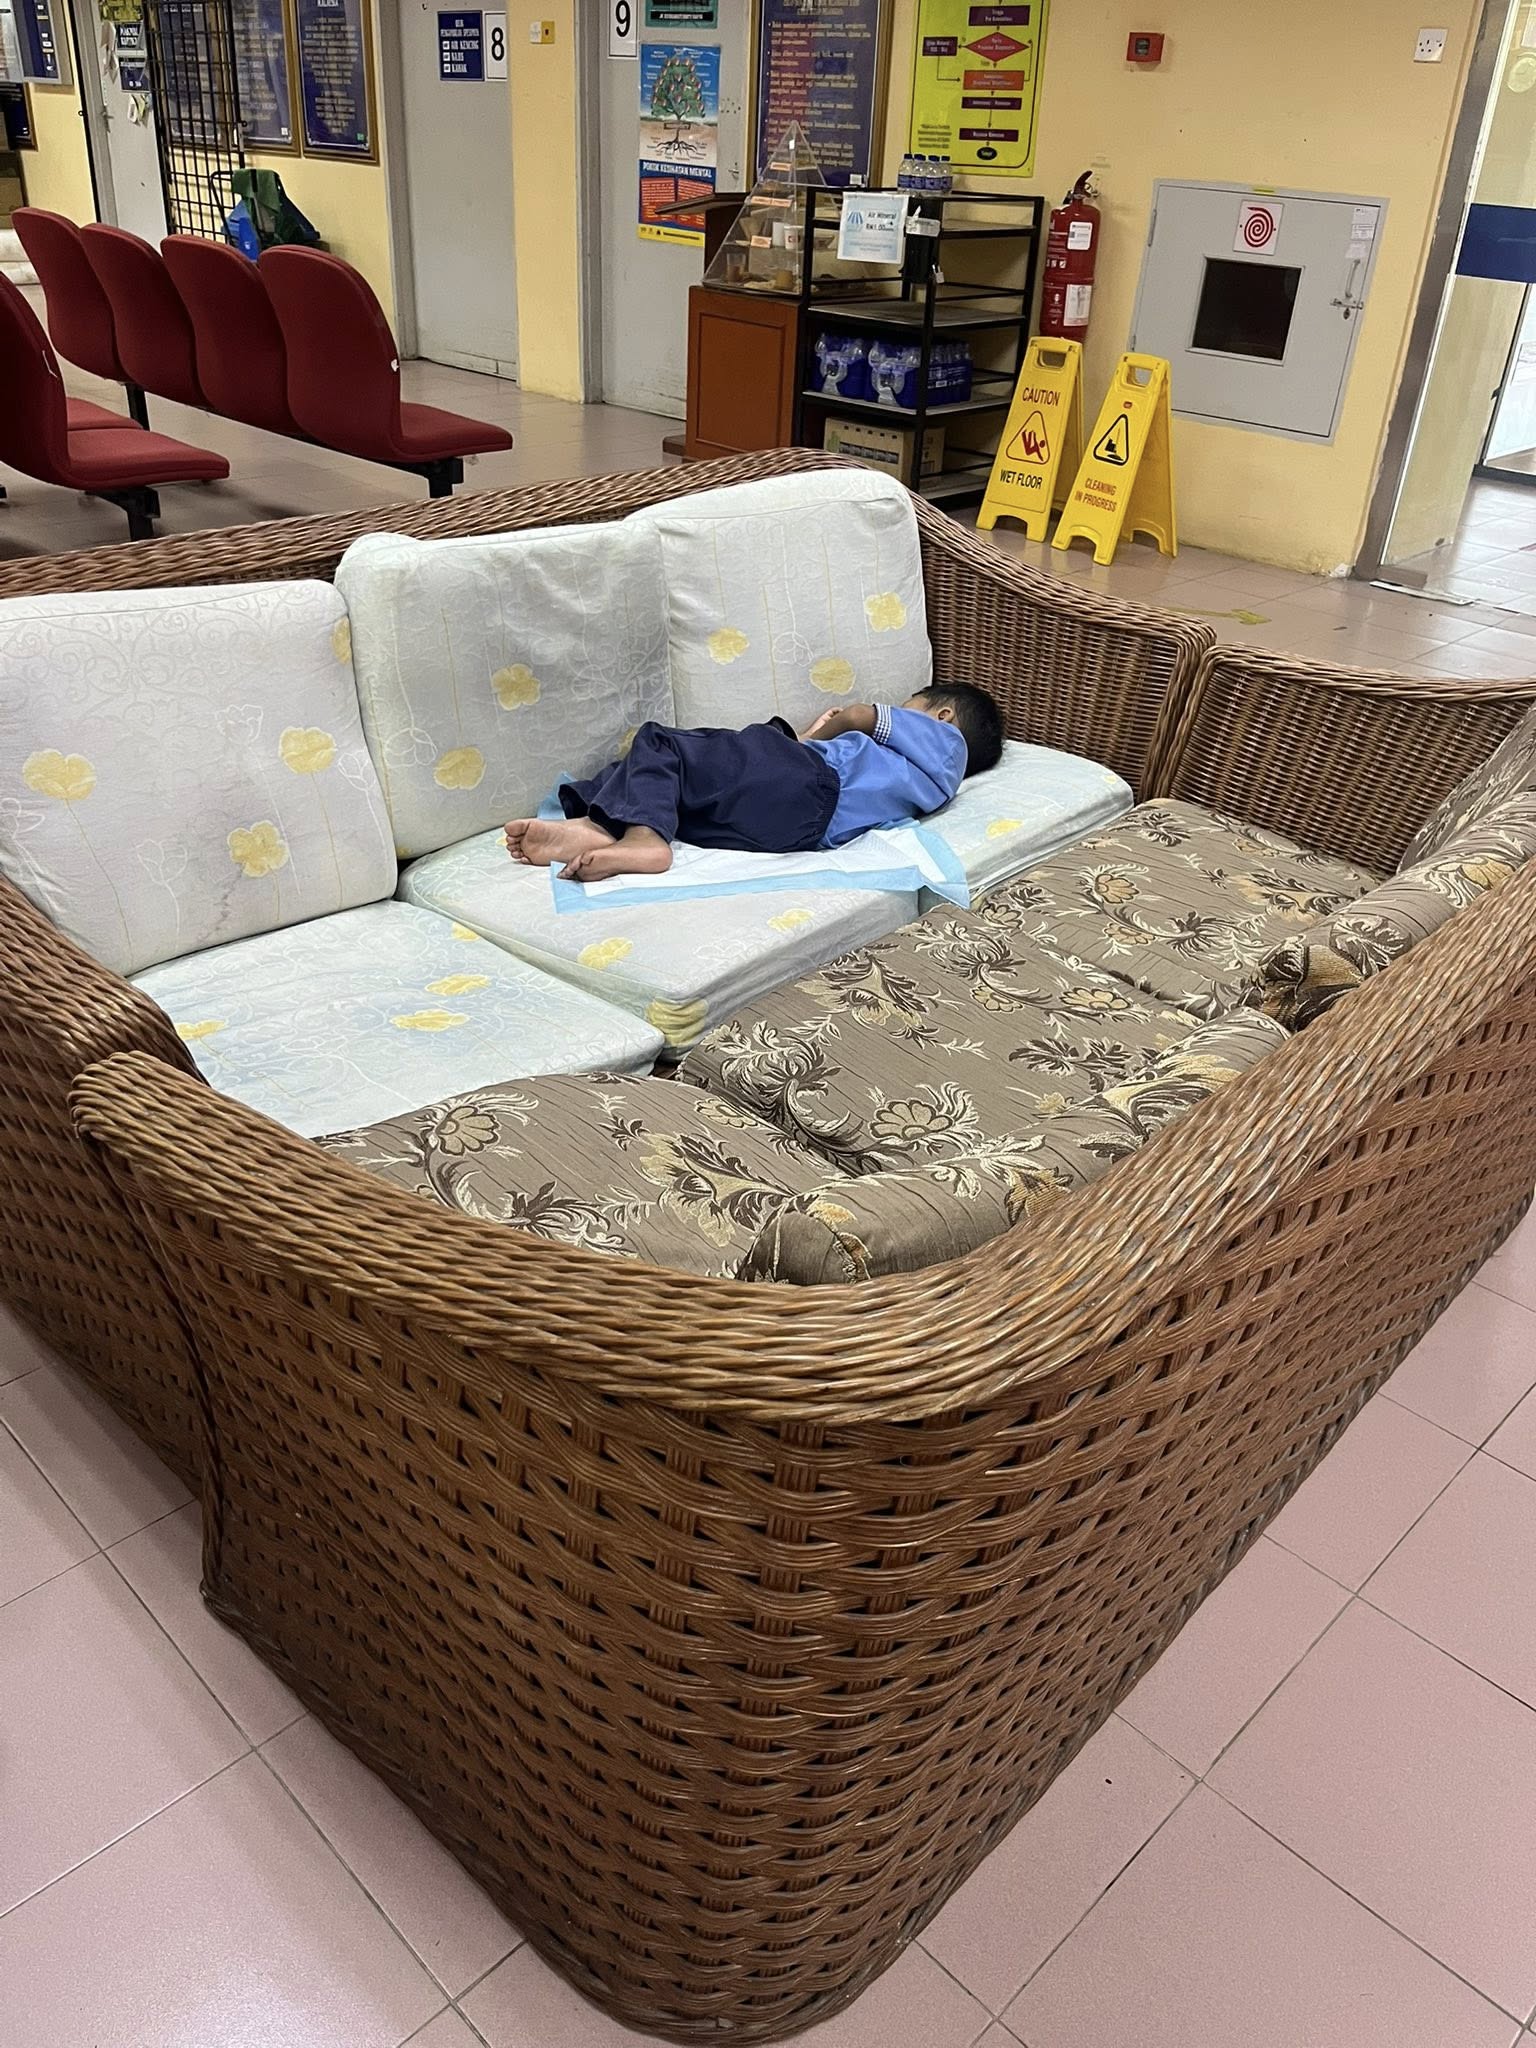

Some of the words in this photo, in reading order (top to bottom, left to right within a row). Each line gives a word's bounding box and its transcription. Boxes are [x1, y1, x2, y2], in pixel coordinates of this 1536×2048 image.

[615, 0, 631, 37] 9
[491, 27, 505, 61] 8
[690, 167, 712, 177] MENTAL
[1022, 387, 1061, 406] CAUTION
[1000, 469, 1016, 483] WET
[1016, 473, 1042, 489] FLOOR
[1085, 478, 1117, 496] CLEANING
[1075, 491, 1083, 501] IN
[1083, 494, 1117, 512] PROGRESS
